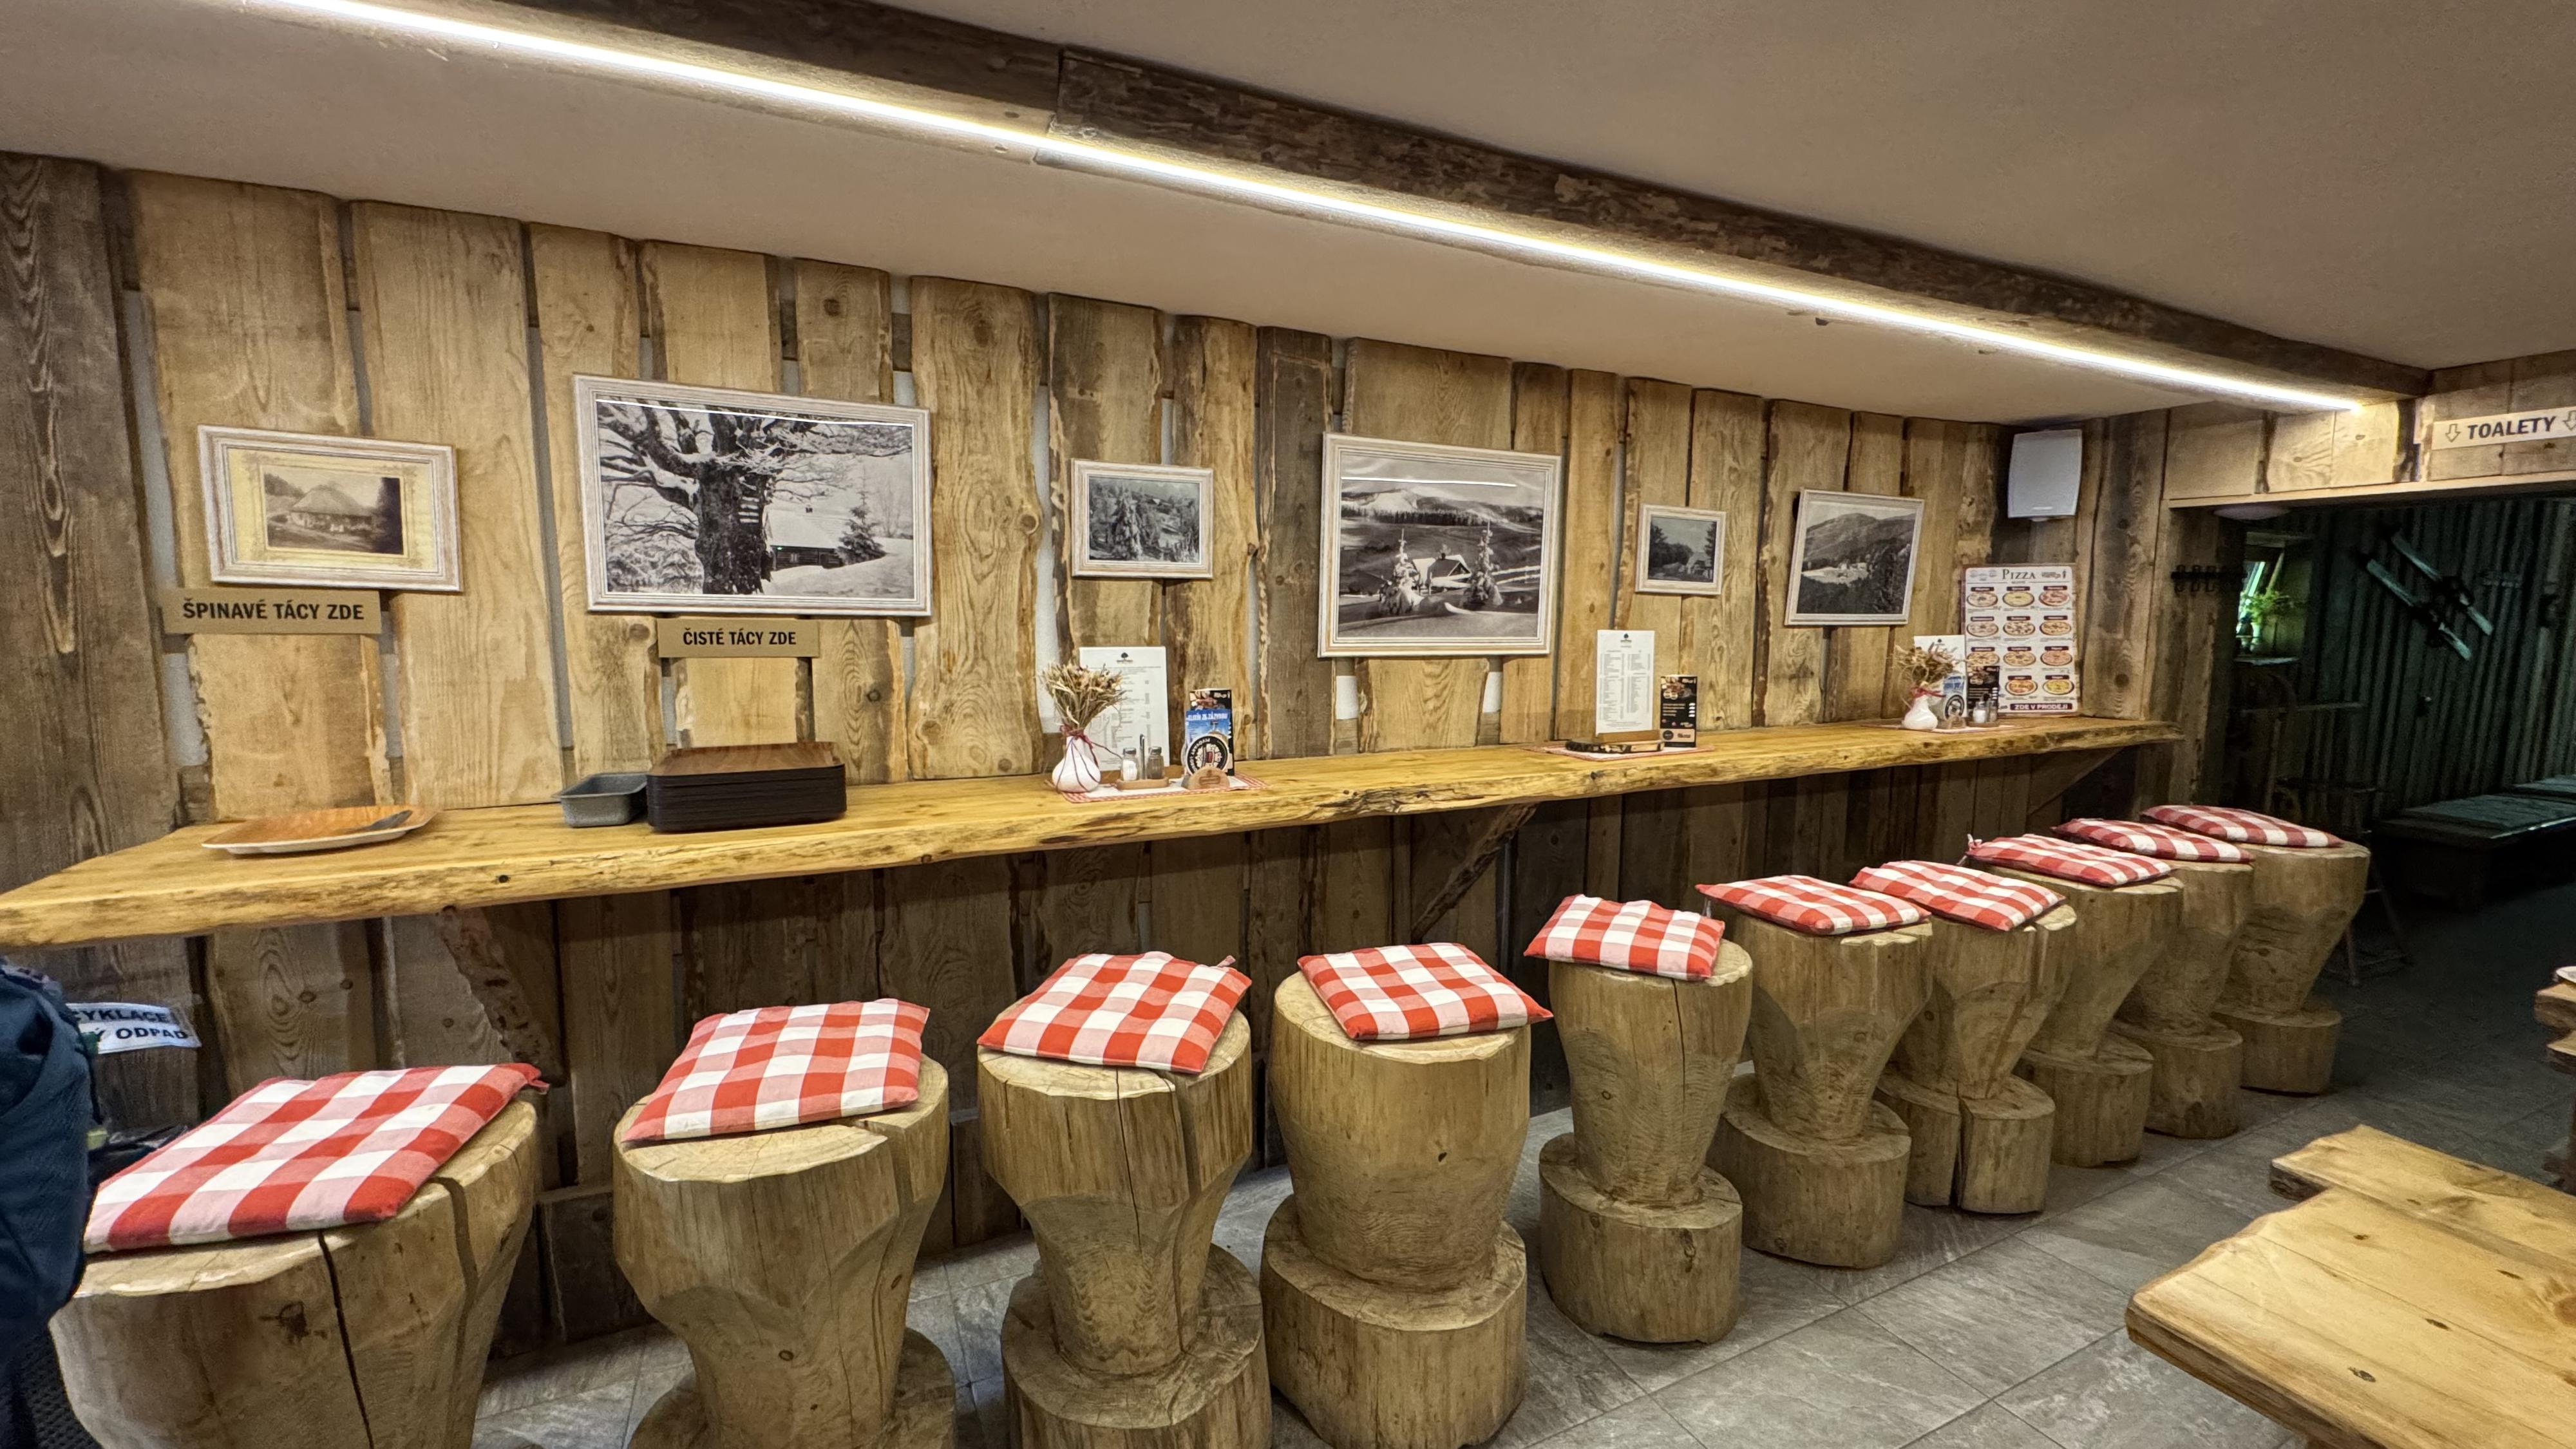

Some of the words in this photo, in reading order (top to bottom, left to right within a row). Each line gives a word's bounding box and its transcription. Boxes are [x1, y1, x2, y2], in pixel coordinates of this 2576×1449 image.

[2467, 416, 2556, 440] TOALETY
[2002, 569, 2036, 580] PIZZA
[183, 598, 267, 620] ŠPINAVÉ
[273, 599, 320, 620] TÁCY
[327, 604, 365, 620] ZDE
[683, 628, 724, 645] ČISTÉ
[728, 628, 764, 645] TÁCY
[769, 631, 796, 645] ZDE
[116, 1027, 189, 1039] ODPAD
